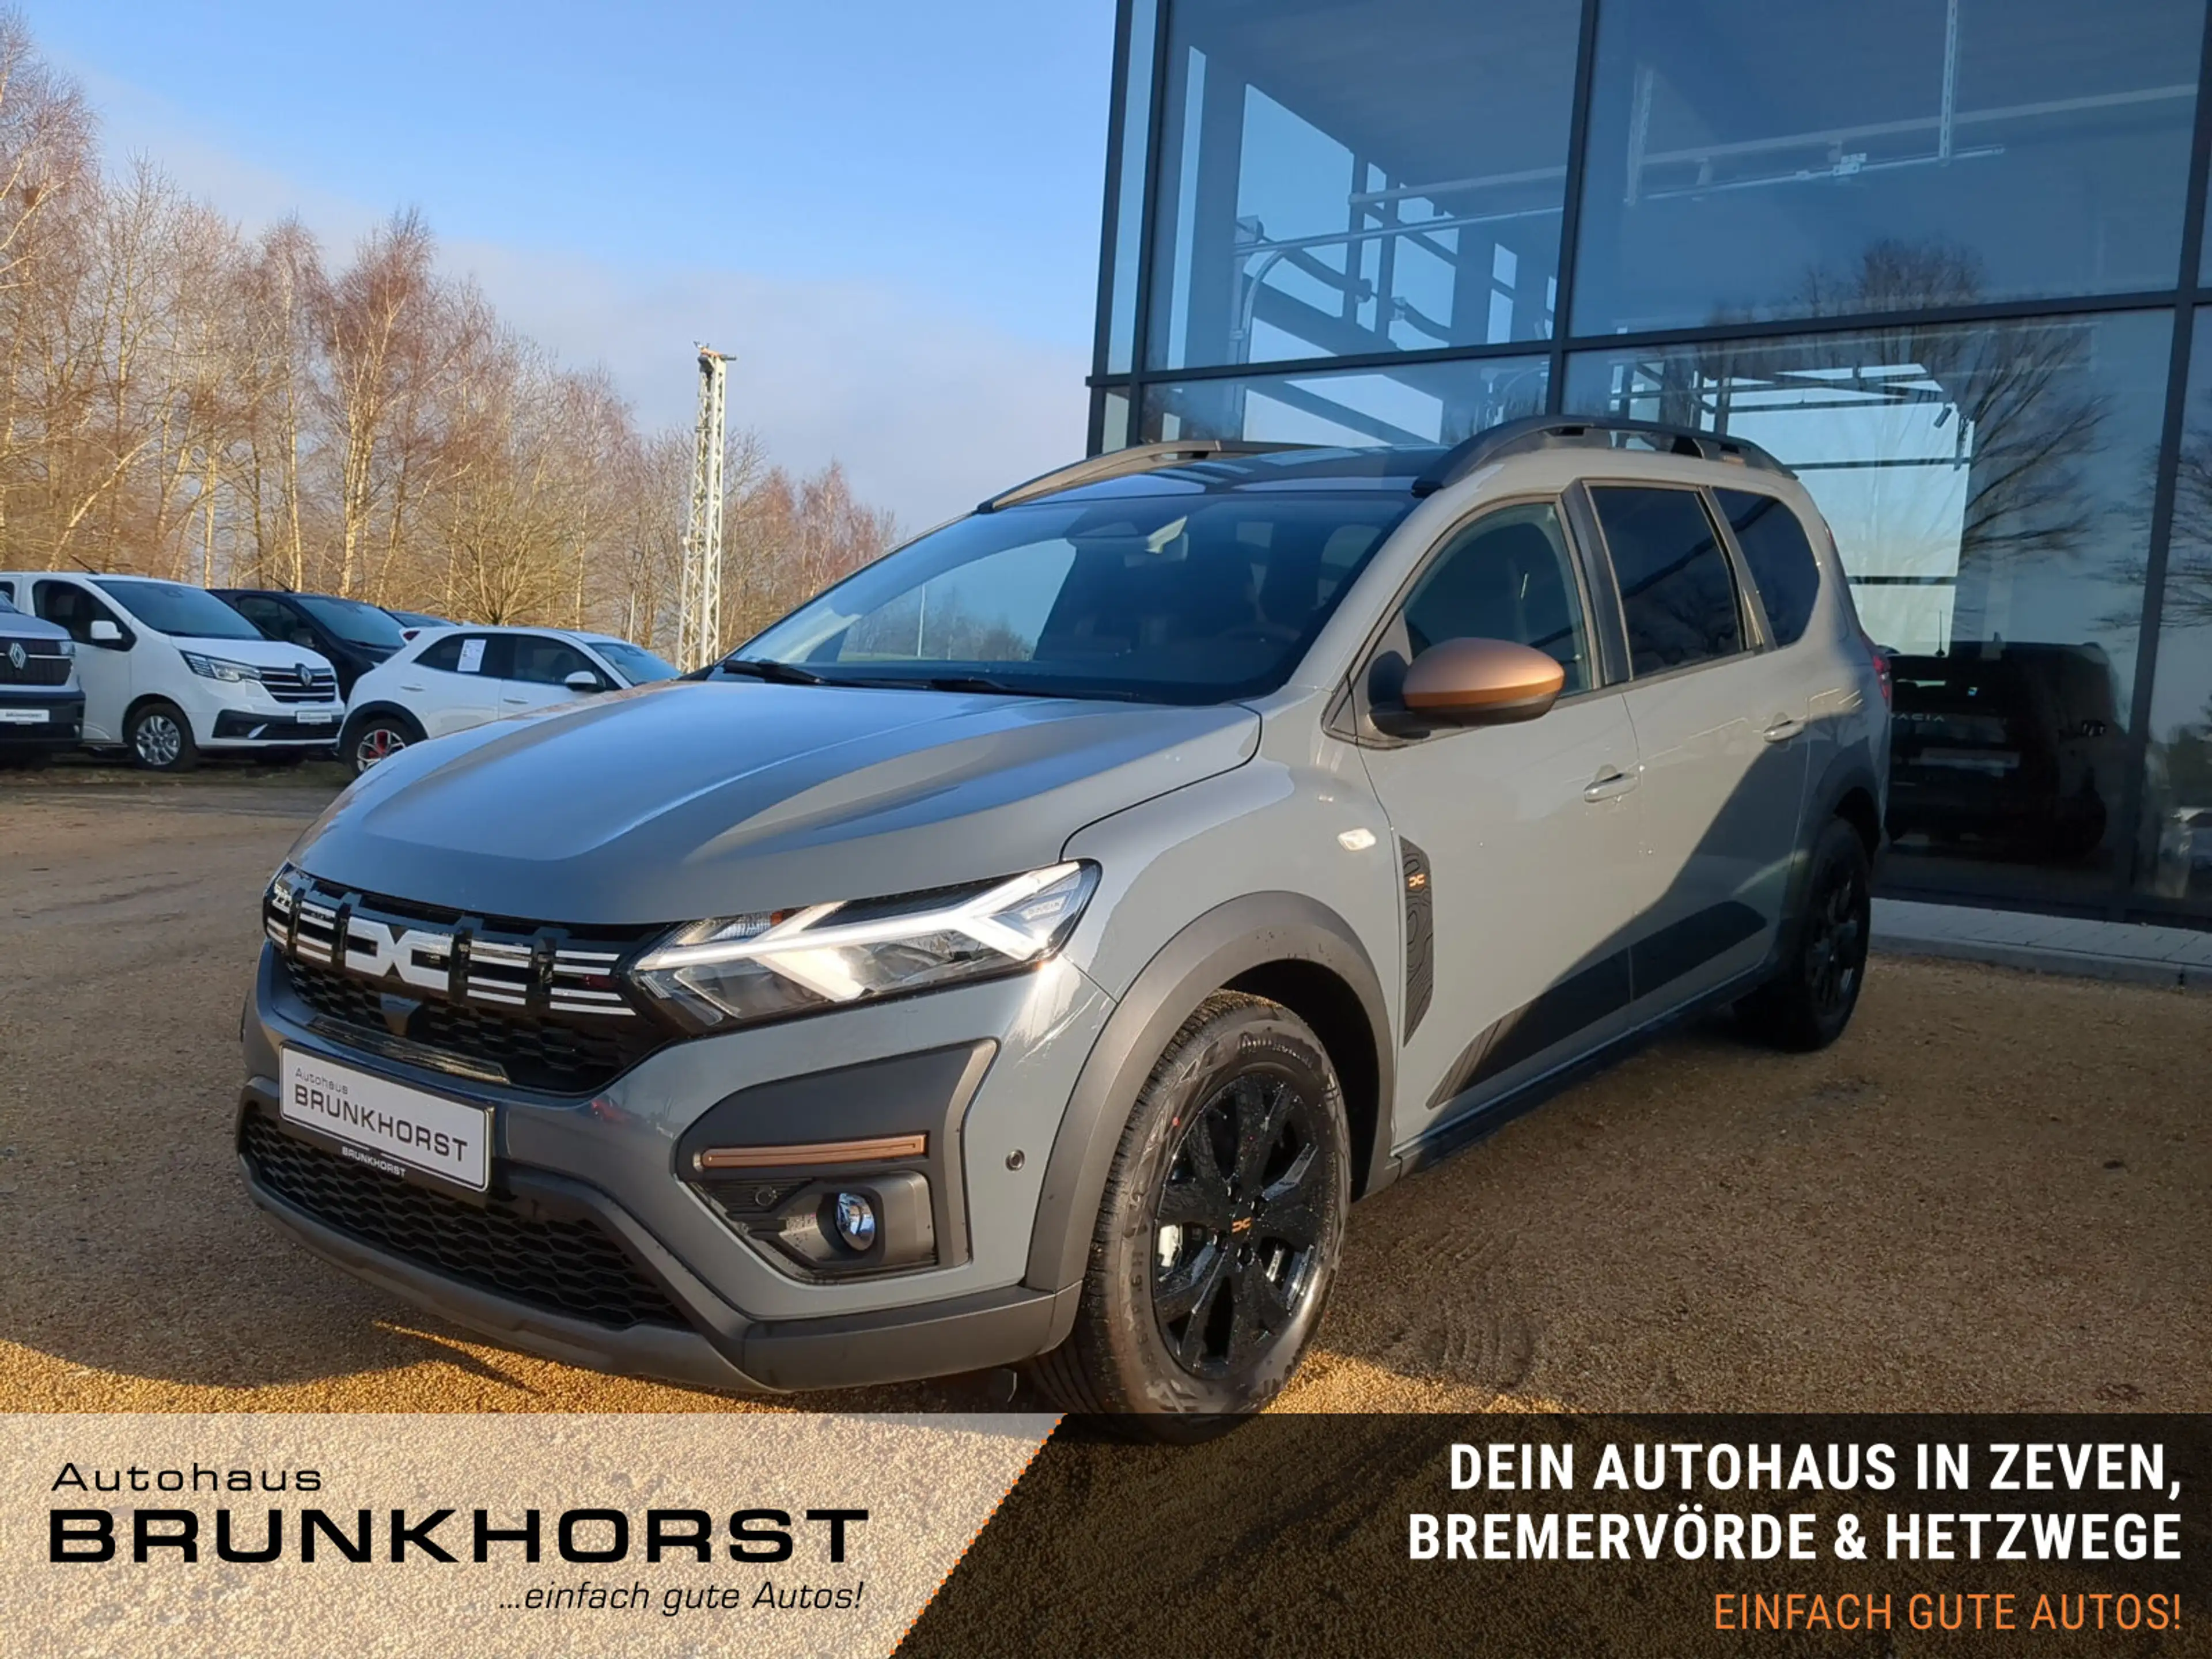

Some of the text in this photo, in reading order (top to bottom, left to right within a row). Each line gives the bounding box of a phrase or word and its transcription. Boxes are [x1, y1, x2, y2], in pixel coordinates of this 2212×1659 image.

[294, 1067, 349, 1095] Autohaus
[294, 1083, 468, 1161] BRUNKHORST
[342, 1146, 407, 1178] BRUNKHORST
